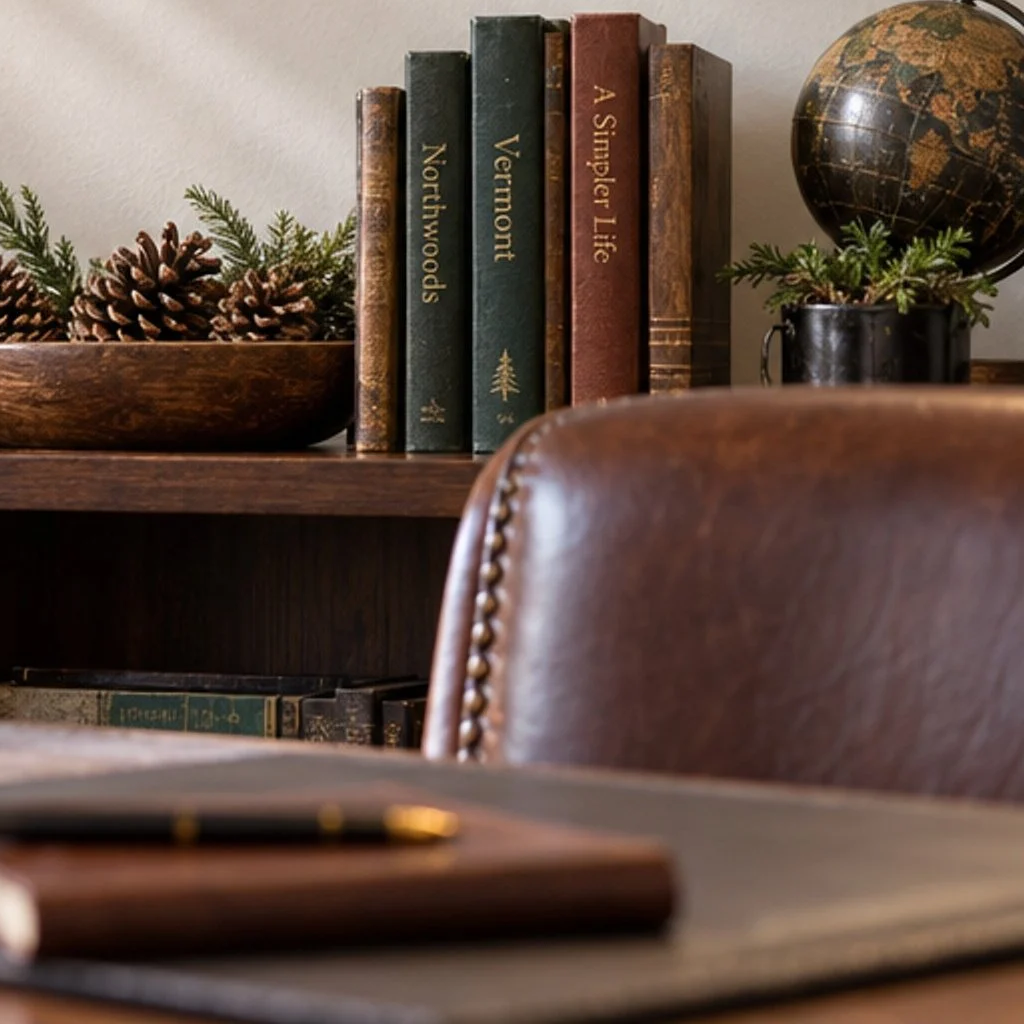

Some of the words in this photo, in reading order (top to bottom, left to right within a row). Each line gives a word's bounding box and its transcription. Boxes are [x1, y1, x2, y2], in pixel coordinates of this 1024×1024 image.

[593, 83, 617, 105] A
[493, 133, 521, 263] Vermont
[585, 113, 618, 210] Simpler
[421, 142, 448, 304] Northwoods
[592, 216, 618, 265] Life
